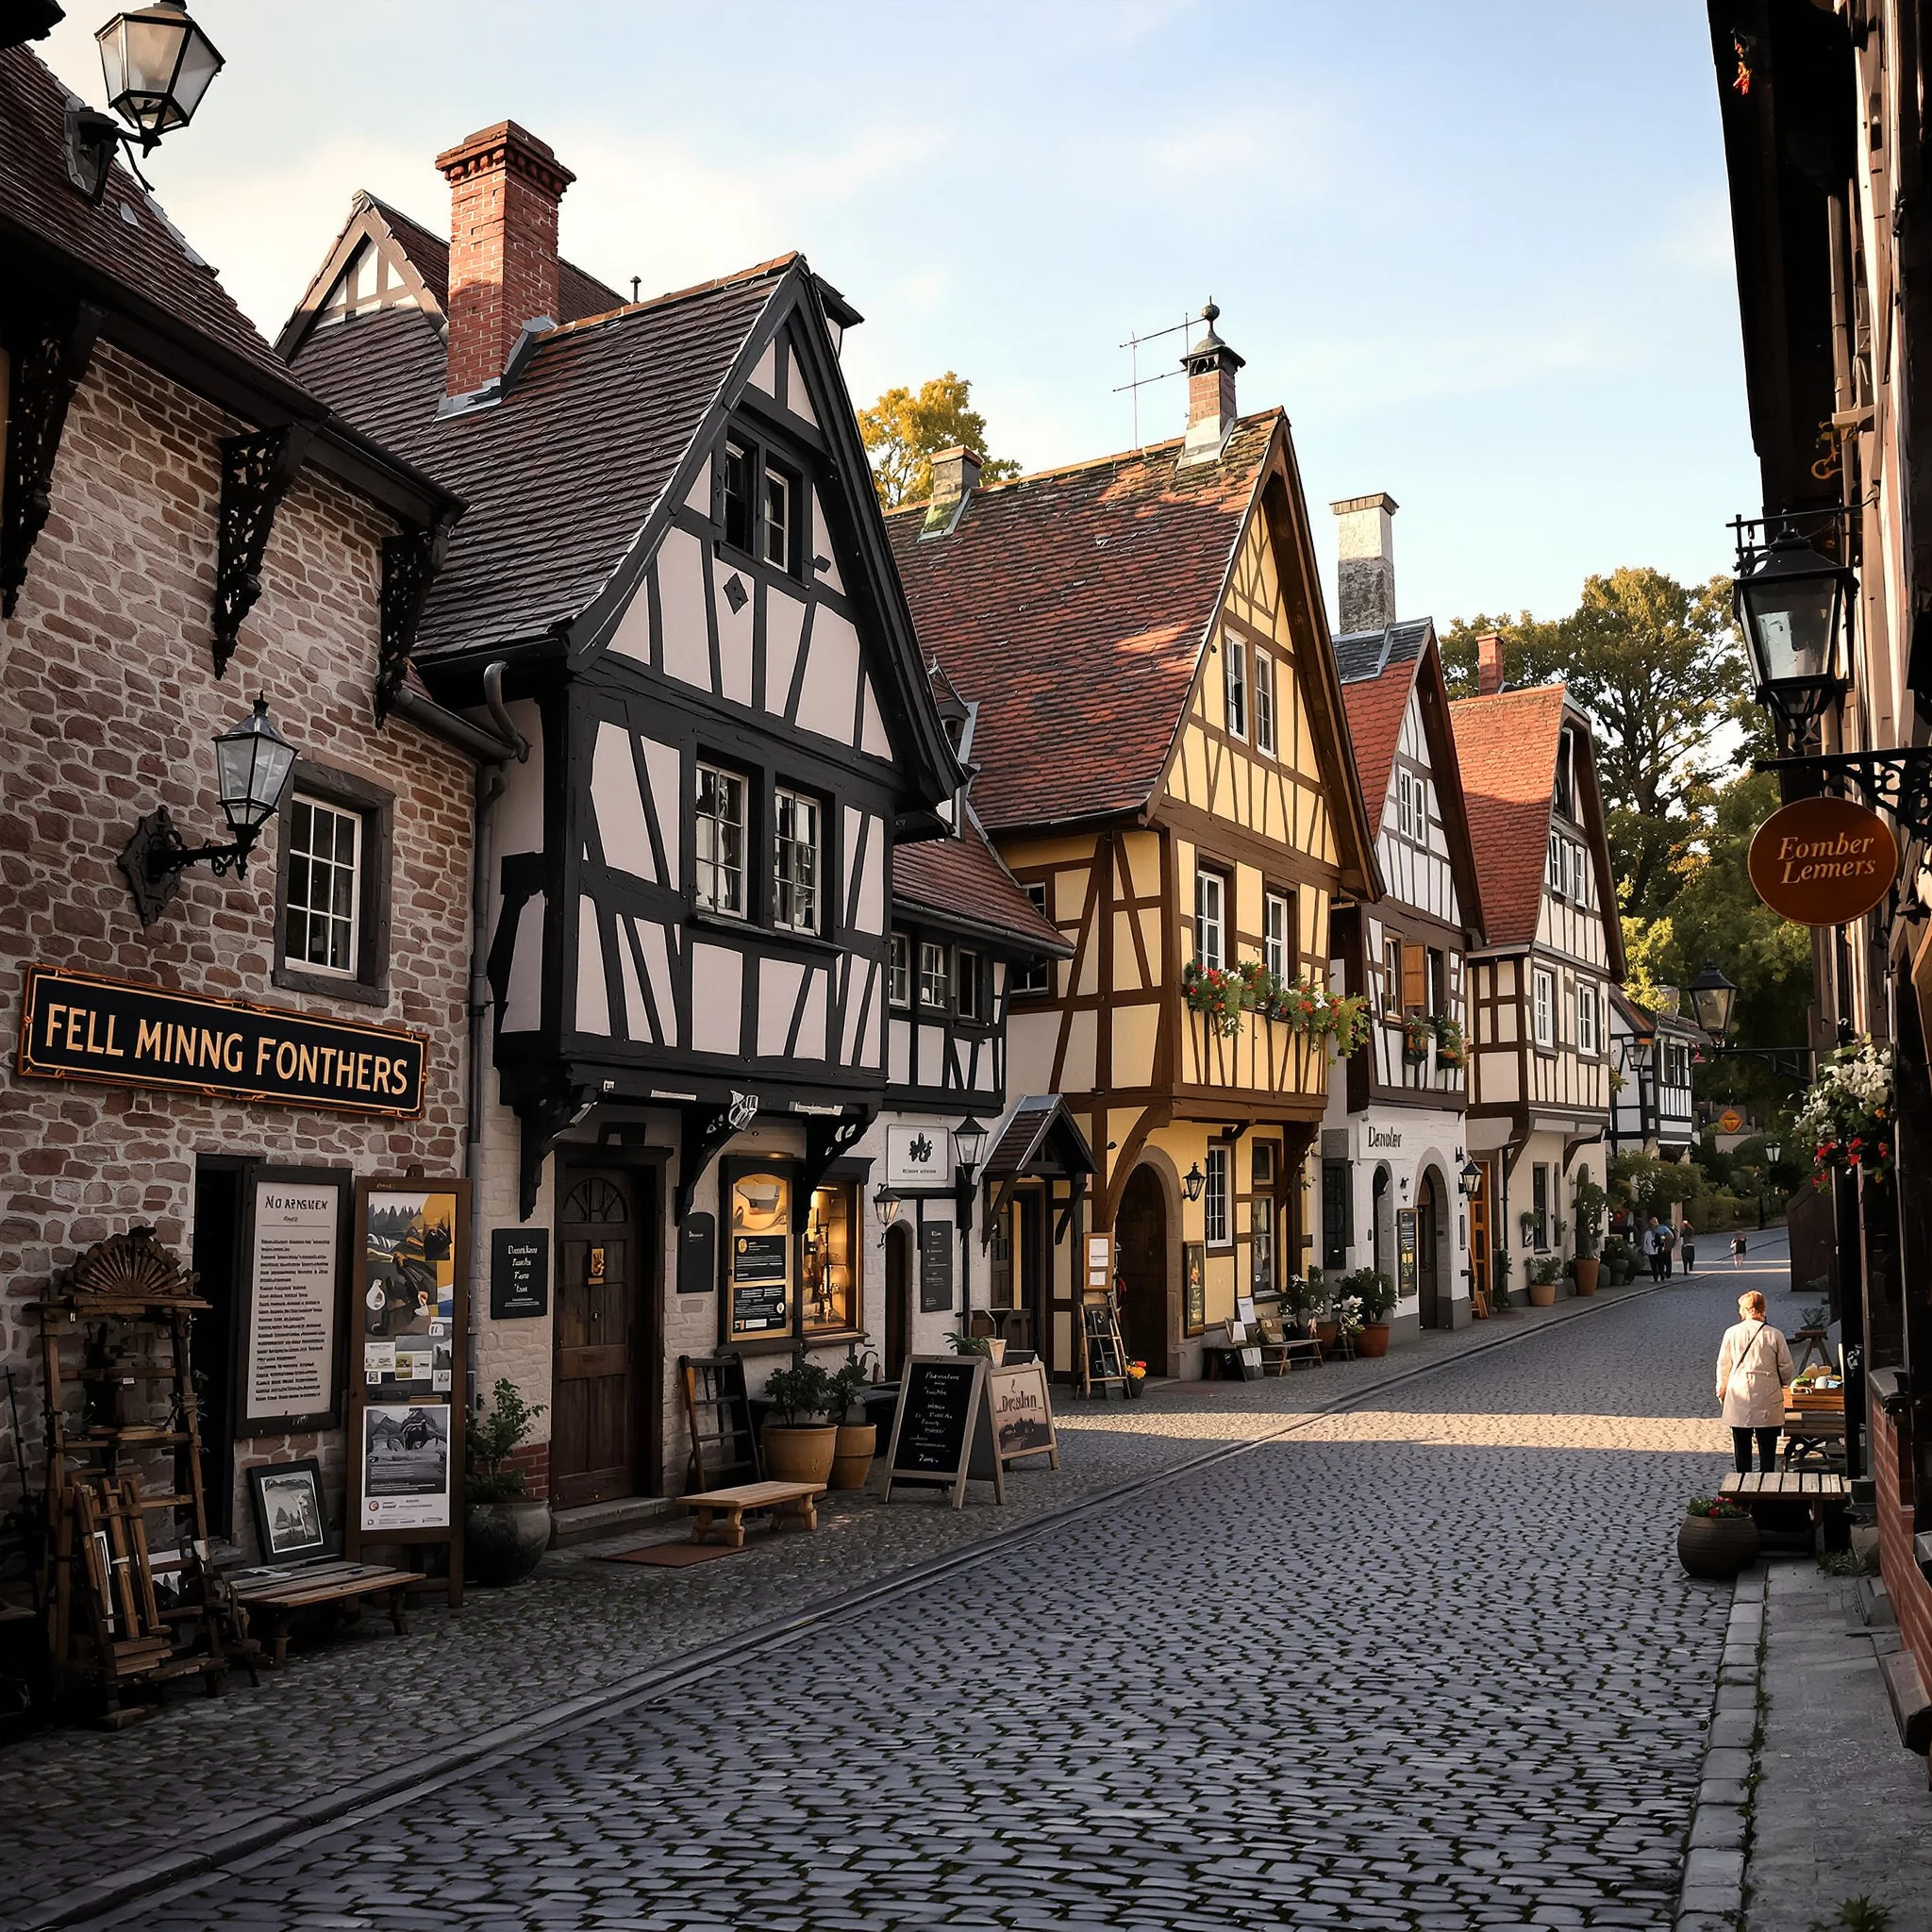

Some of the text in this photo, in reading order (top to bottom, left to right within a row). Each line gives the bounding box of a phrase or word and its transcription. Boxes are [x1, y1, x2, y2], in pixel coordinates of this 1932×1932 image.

[1775, 832, 1874, 860] Eomber
[45, 1003, 408, 1095] FELL MINNG FONTHERS
